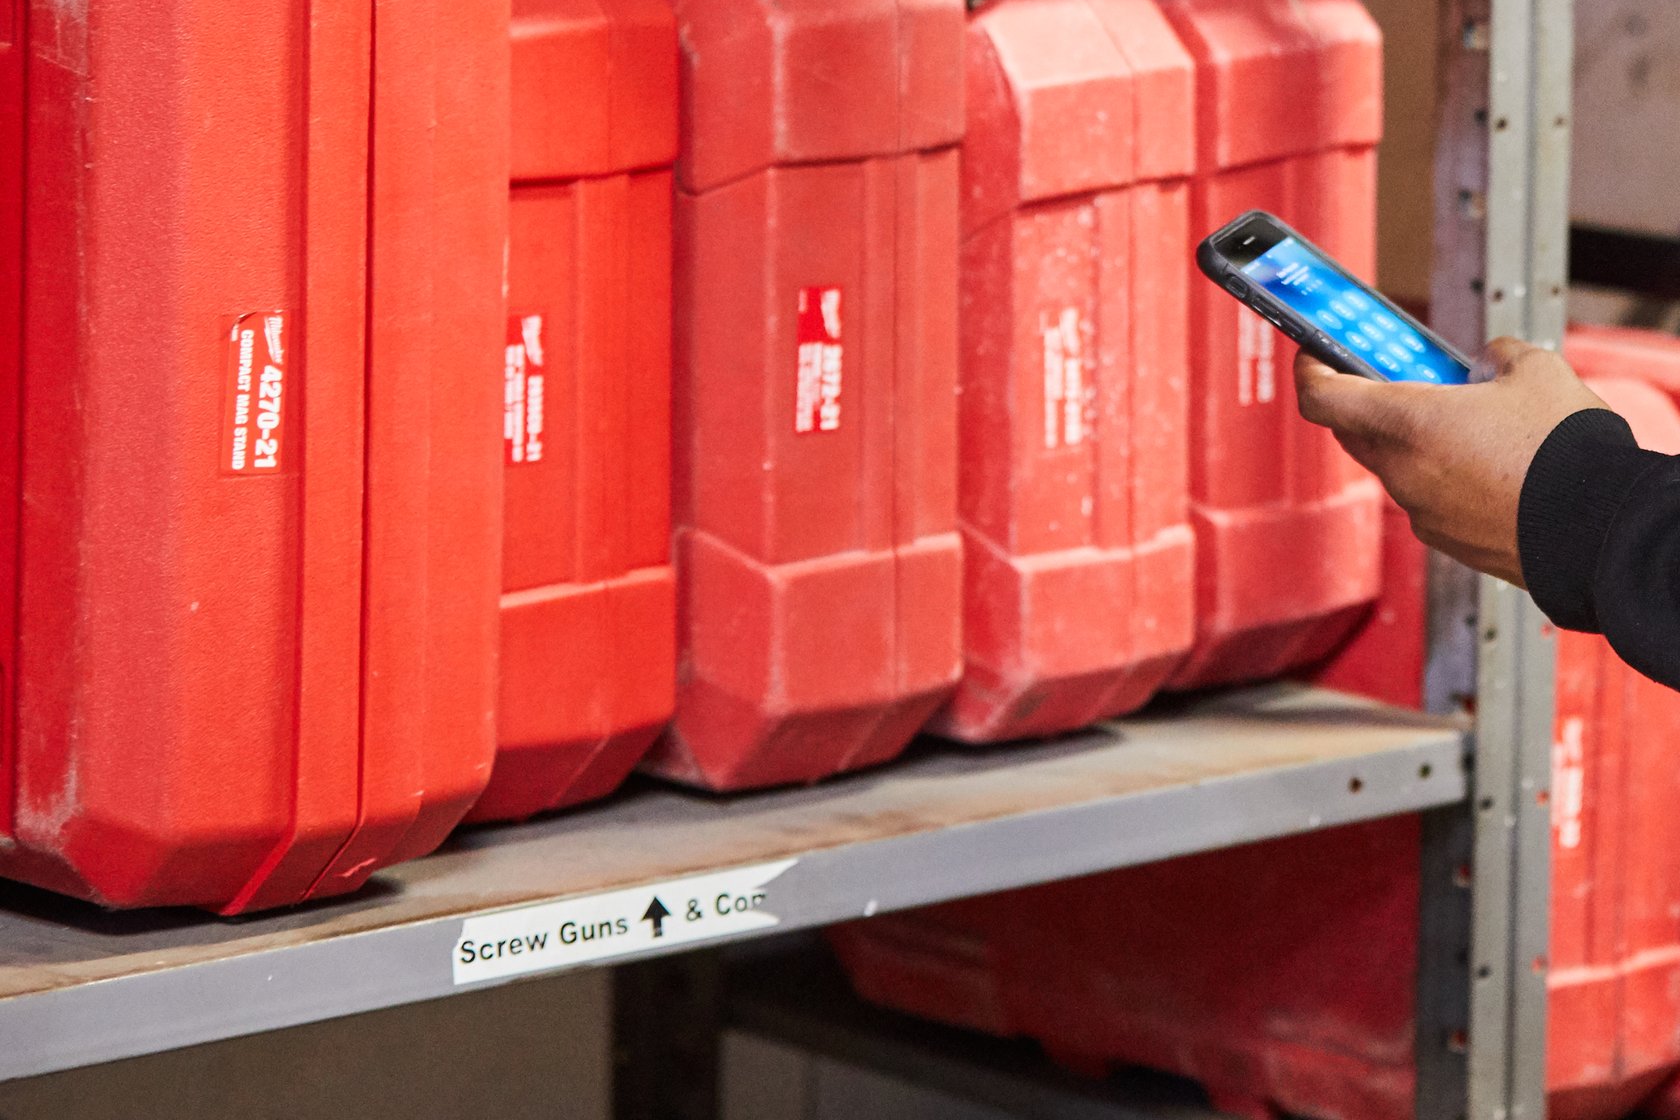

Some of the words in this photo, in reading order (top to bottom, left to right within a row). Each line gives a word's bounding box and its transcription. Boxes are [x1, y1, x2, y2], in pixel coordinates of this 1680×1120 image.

[237, 329, 254, 392] COMPACT
[235, 394, 250, 425] MAG
[254, 365, 283, 468] 4270-21
[232, 427, 248, 470] STAND
[460, 930, 548, 965] Screw
[559, 917, 628, 945] Guns
[685, 898, 703, 922] &
